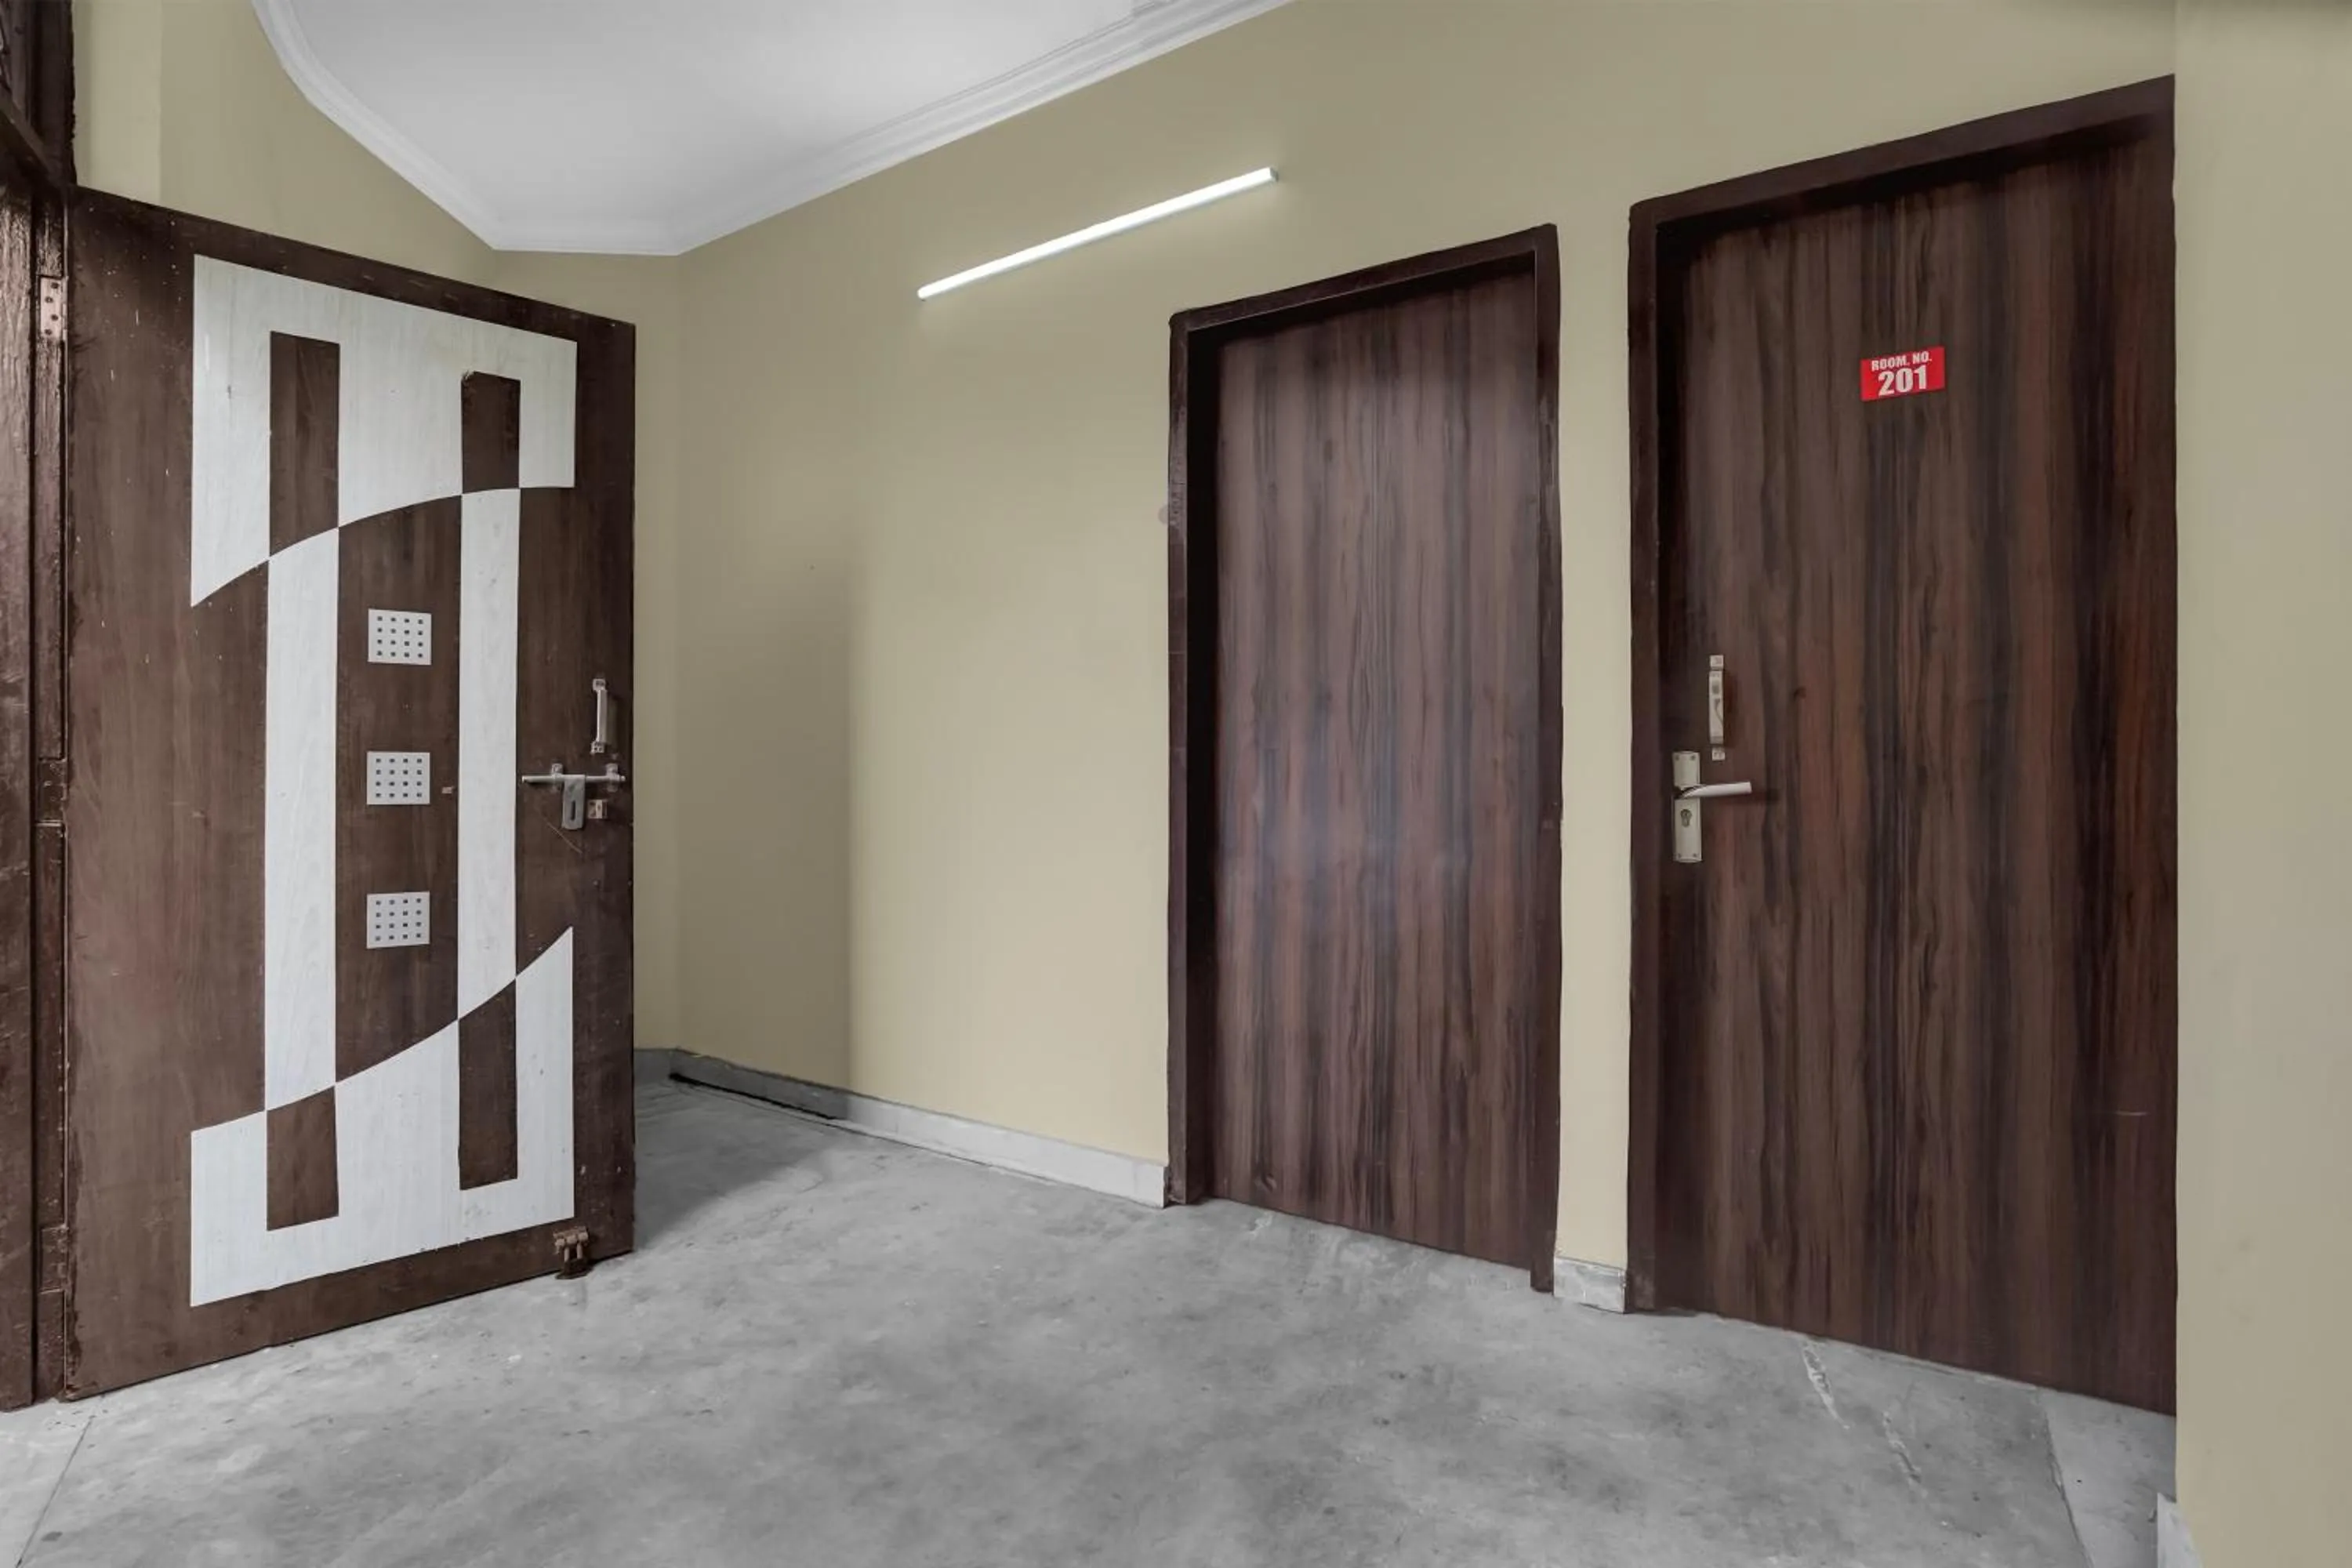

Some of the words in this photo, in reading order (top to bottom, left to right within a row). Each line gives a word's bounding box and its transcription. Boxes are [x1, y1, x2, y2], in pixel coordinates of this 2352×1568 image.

[1871, 355, 1910, 372] ROOM.
[1912, 350, 1932, 365] NO.
[1878, 365, 1926, 397] 201
